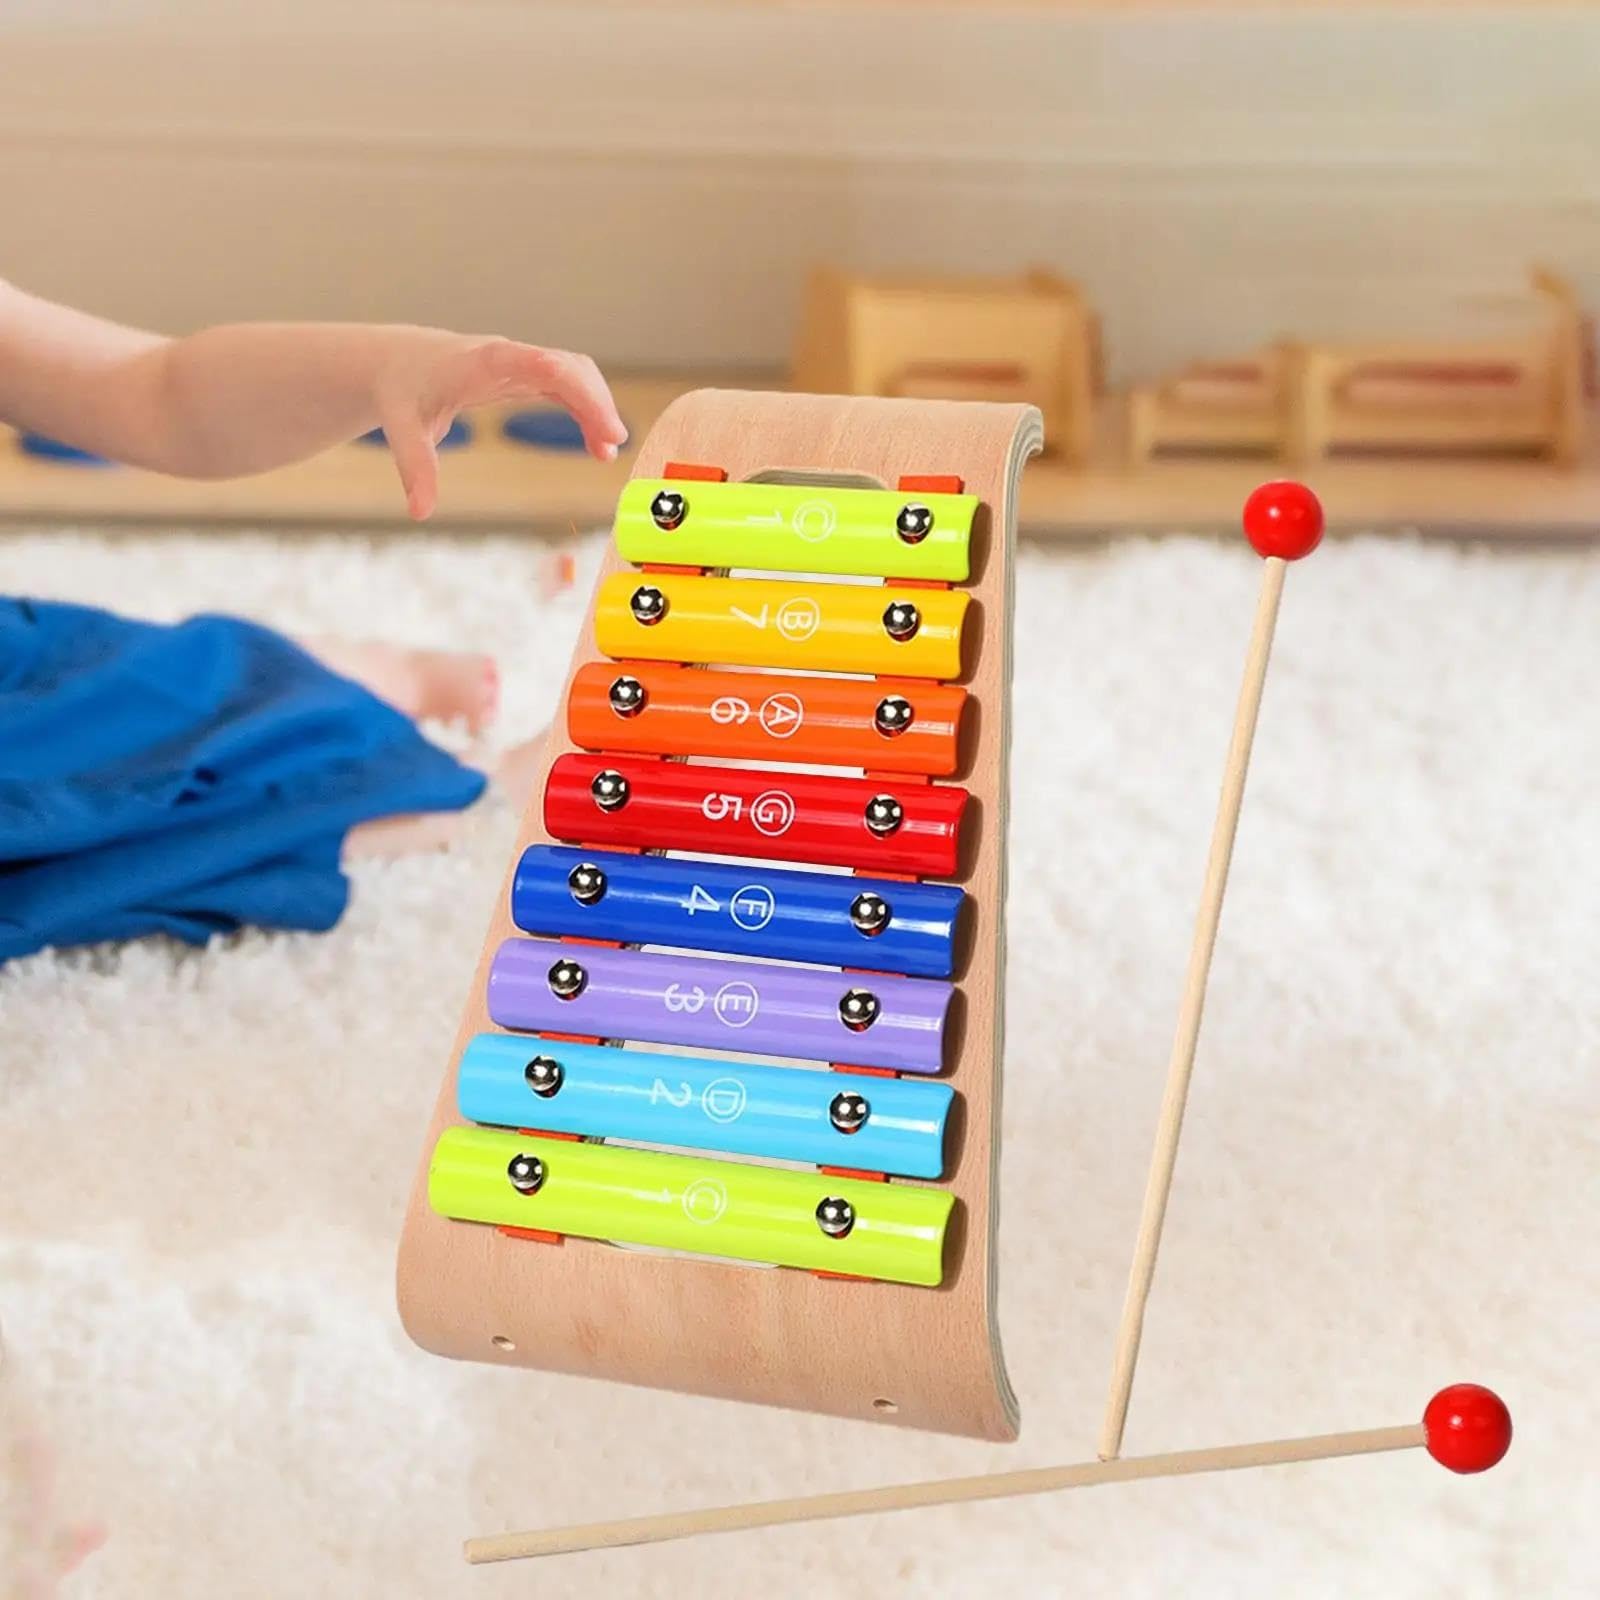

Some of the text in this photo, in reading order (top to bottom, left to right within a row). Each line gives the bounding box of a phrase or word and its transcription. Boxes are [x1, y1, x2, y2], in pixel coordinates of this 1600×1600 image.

[729, 603, 769, 629] 7
[710, 696, 750, 724] 6
[702, 791, 743, 821] 5
[680, 884, 721, 916] 4
[664, 982, 705, 1013] 3
[650, 1077, 692, 1108] 2
